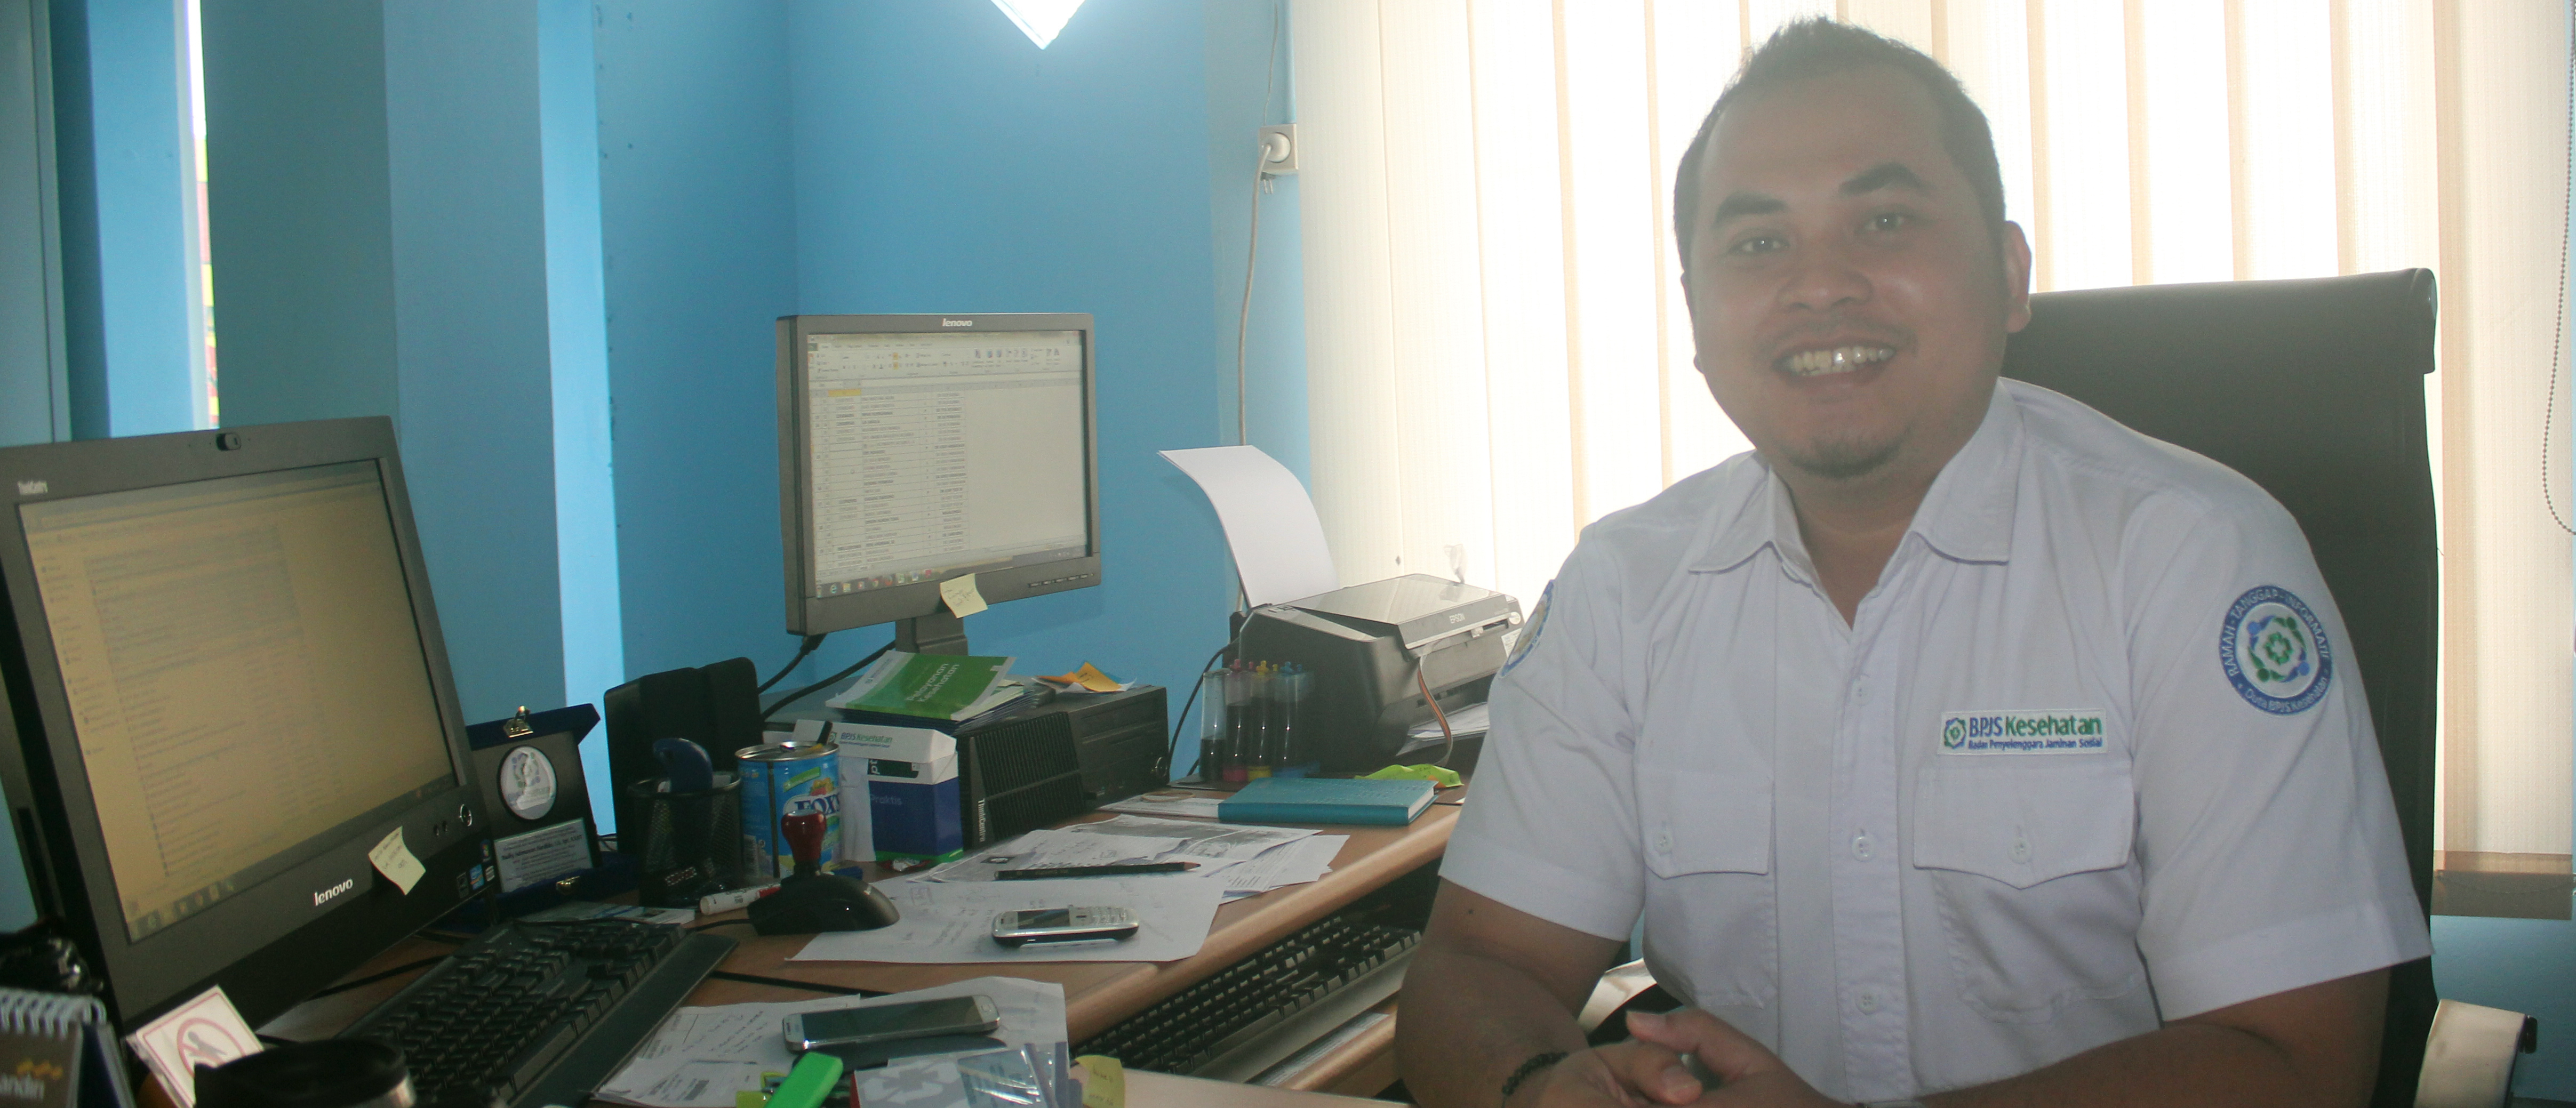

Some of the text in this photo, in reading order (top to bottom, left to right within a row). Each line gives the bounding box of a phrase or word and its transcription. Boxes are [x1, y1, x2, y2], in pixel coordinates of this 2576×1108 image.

[942, 318, 972, 327] lenovo
[1449, 613, 1466, 624] EPSON
[2221, 625, 2240, 677] RAMAH
[904, 663, 950, 701] Pelayanan
[1969, 715, 2102, 737] BPJS Kesehatan
[314, 879, 353, 906] lenovo
